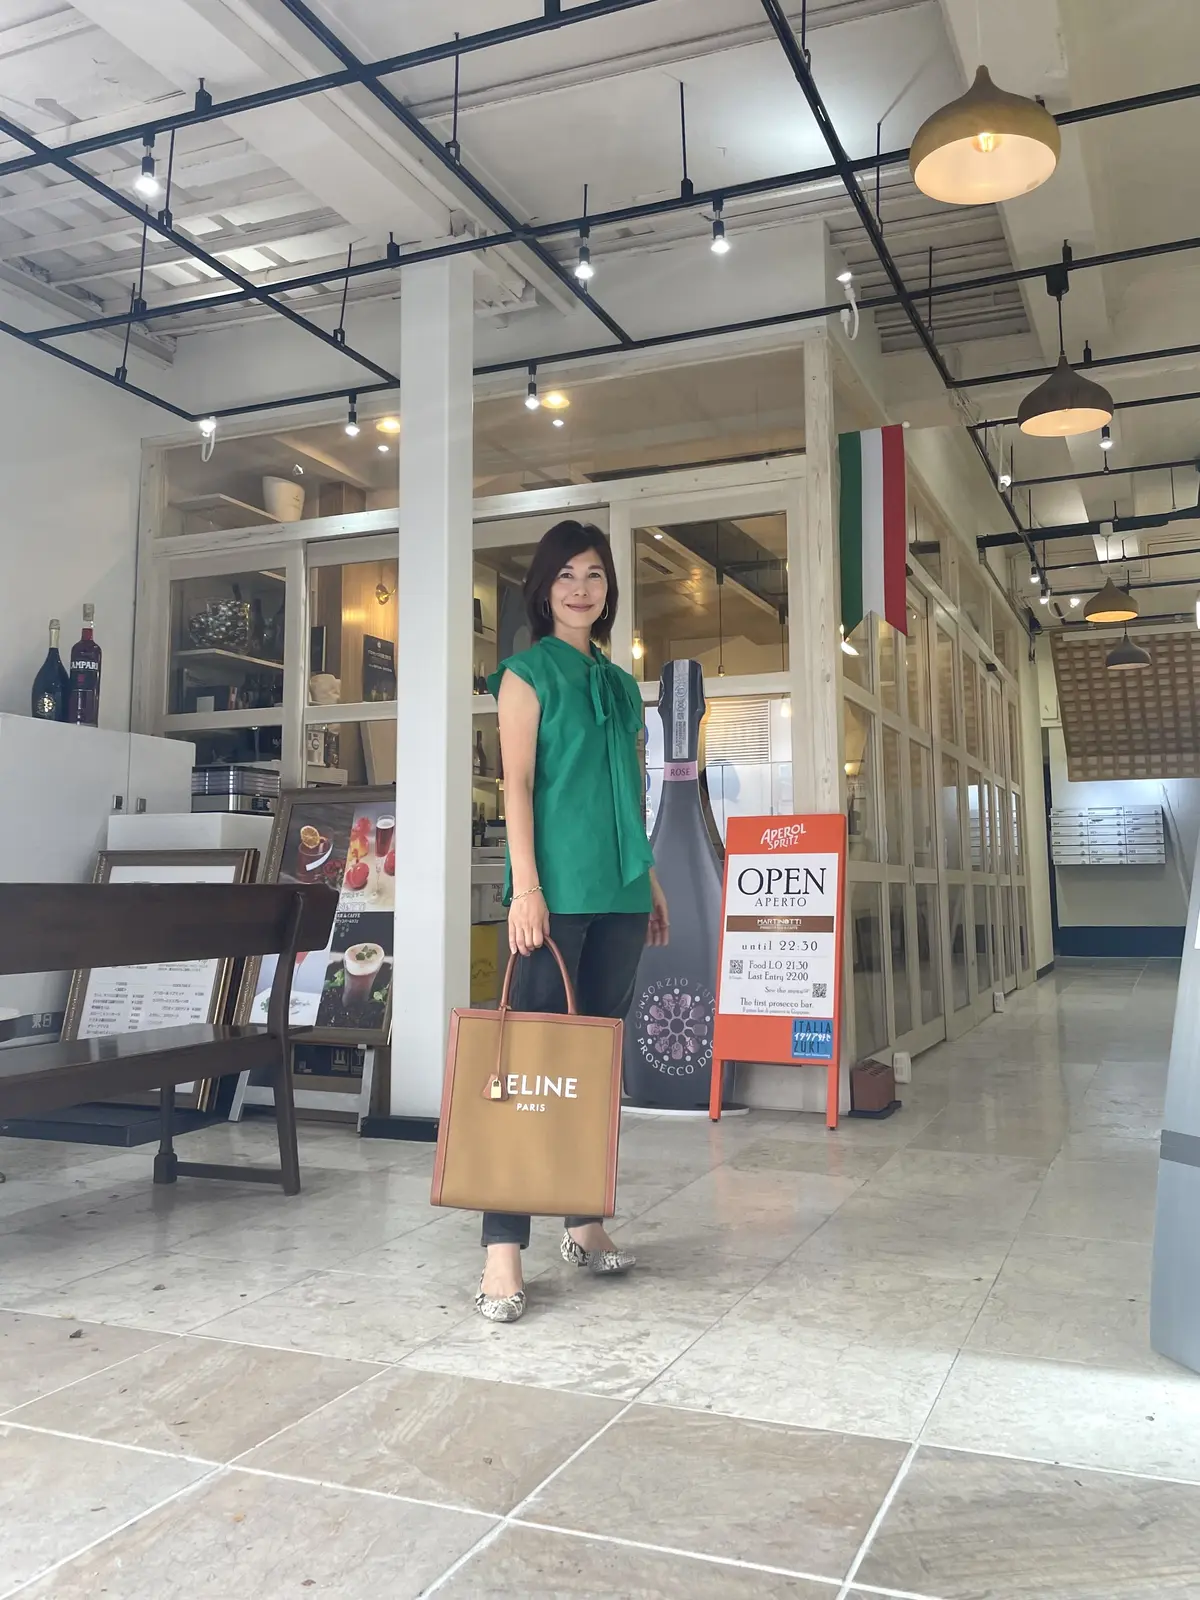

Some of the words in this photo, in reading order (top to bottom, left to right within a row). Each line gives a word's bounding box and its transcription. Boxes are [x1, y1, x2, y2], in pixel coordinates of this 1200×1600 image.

[760, 823, 807, 845] APEROL
[738, 868, 827, 895] OPEN
[755, 897, 807, 907] APERTO
[757, 918, 802, 926] MARTINOTTI
[741, 940, 772, 951] until
[778, 940, 818, 951] 22:30
[749, 960, 766, 970] Food
[748, 971, 763, 980] Last
[765, 971, 784, 982] Entry
[635, 977, 689, 1029] CONSORZIO
[741, 997, 752, 1006] The
[754, 998, 767, 1007] first
[768, 1001, 799, 1009] prosecco
[794, 1021, 832, 1033] ITALIA
[793, 1041, 820, 1053] ZUKI
[637, 1037, 694, 1076] PROSECCO
[507, 1074, 578, 1098] ELINE
[516, 1103, 546, 1112] PARIS
